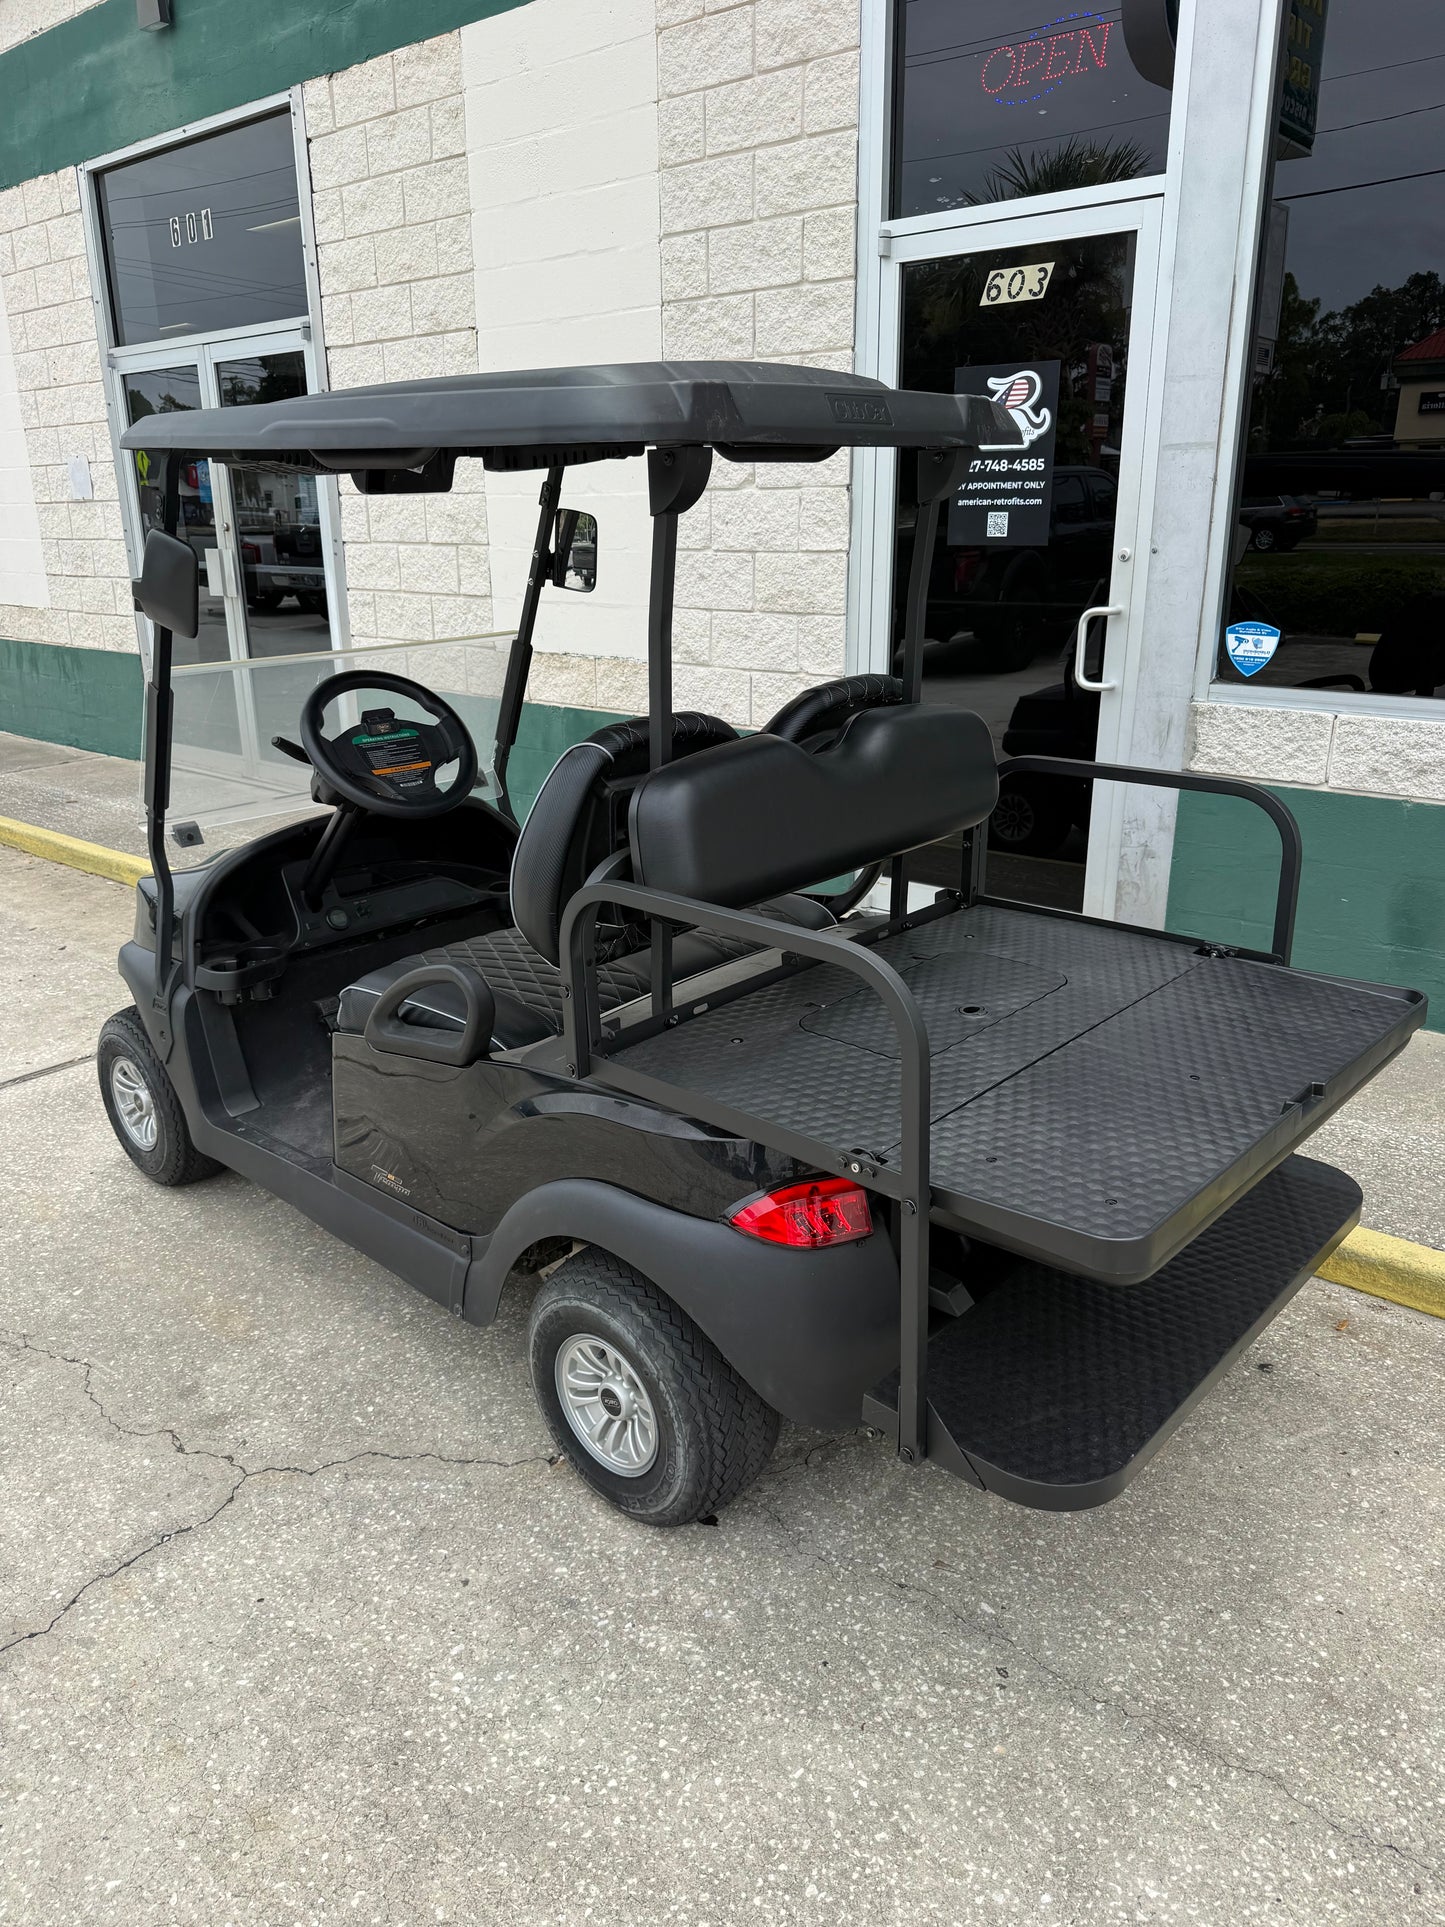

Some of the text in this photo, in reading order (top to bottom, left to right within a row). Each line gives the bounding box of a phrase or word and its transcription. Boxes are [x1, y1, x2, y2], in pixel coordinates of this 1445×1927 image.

[982, 22, 1114, 93] OPEN
[170, 208, 213, 247] 601
[986, 266, 1049, 302] 603
[957, 497, 1043, 506] american-retrofits.com
[967, 481, 1023, 490] APPOINTMENT
[1023, 480, 1046, 489] ONLY
